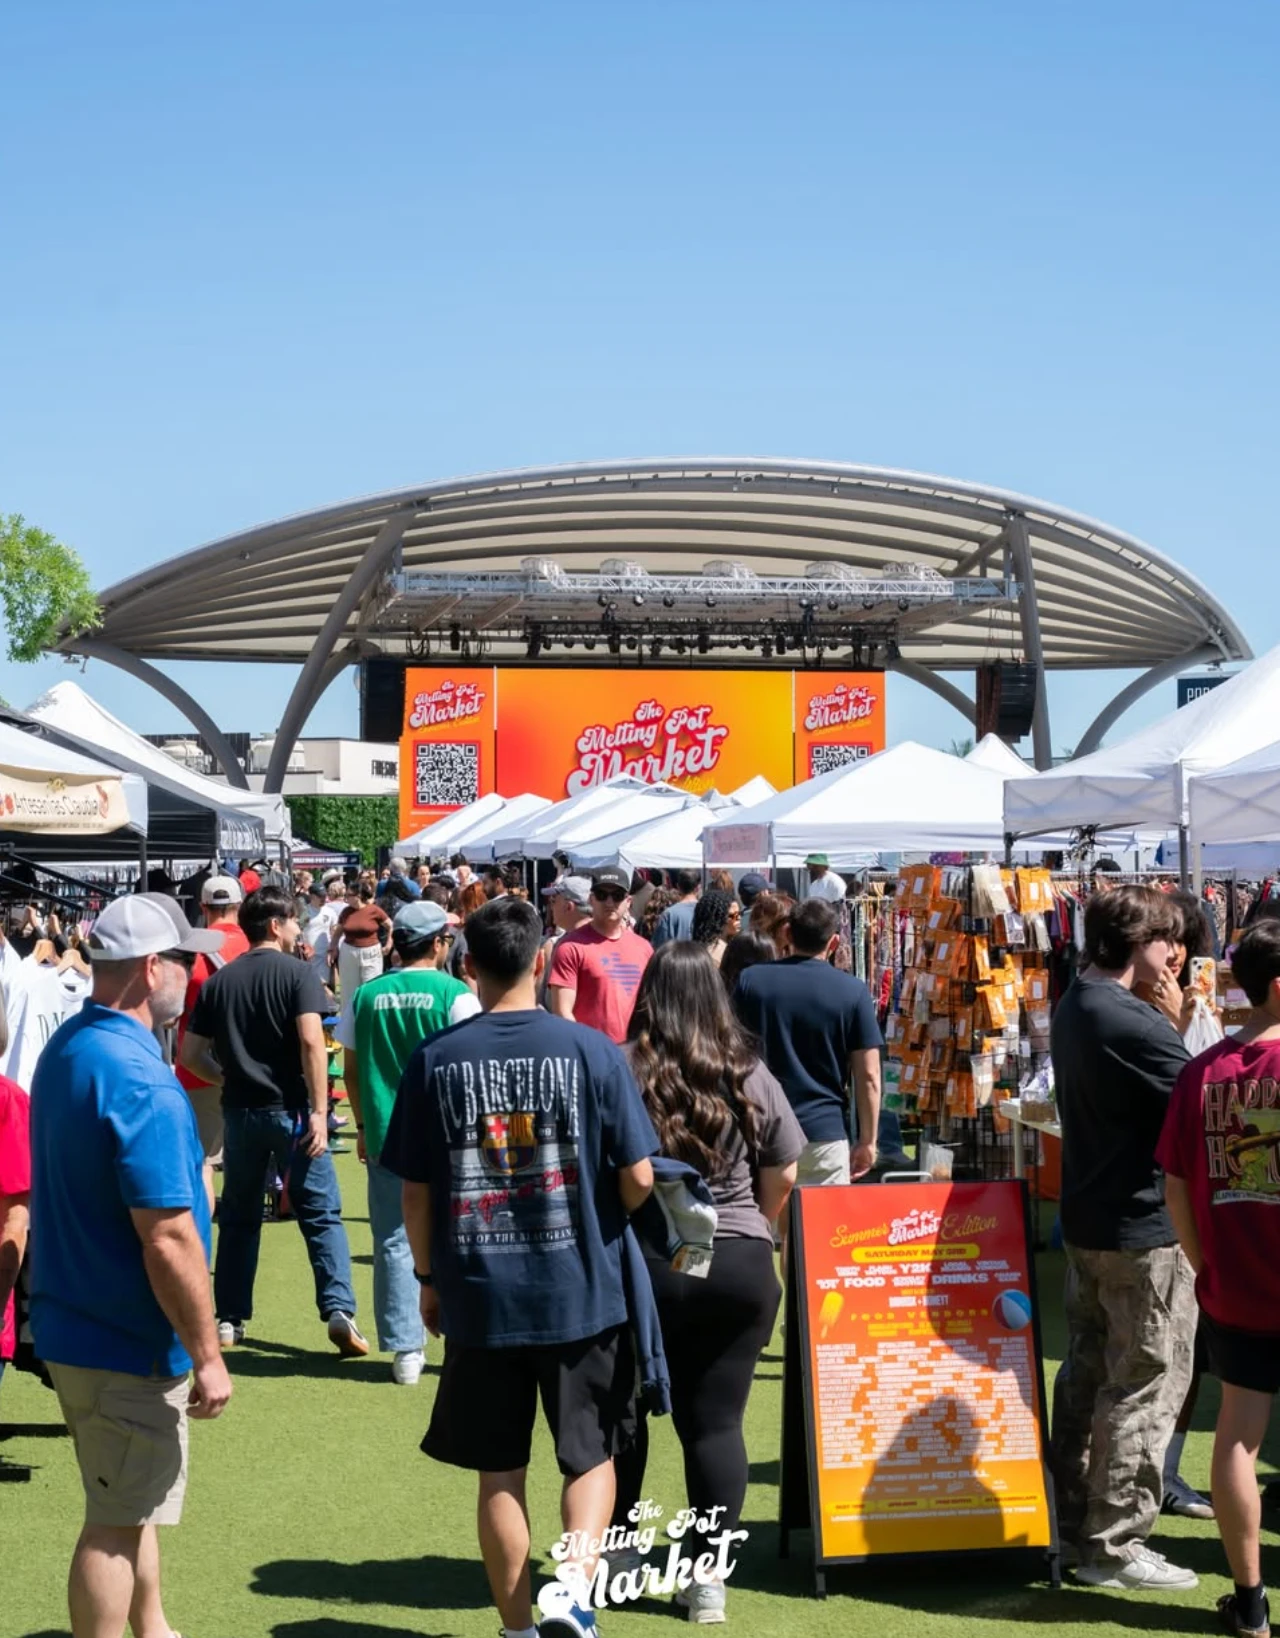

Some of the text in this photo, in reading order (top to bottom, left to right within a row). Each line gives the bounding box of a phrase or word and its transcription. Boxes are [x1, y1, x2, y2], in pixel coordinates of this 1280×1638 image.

[409, 693, 486, 728] Market
[635, 700, 663, 721] The
[804, 696, 877, 730] Market
[577, 706, 712, 754] Melting Pot
[566, 727, 727, 797] Market
[461, 1057, 580, 1138] BARCELONA
[1203, 1077, 1280, 1131] HAPP
[476, 1233, 491, 1244] OF
[494, 1231, 516, 1243] THE
[829, 1223, 889, 1248] Summer
[941, 1214, 998, 1240] Edition
[864, 1250, 918, 1258] SATURDAY
[920, 1249, 945, 1257] MAY
[844, 1275, 886, 1288] FOOD
[931, 1273, 989, 1285] DRINKS
